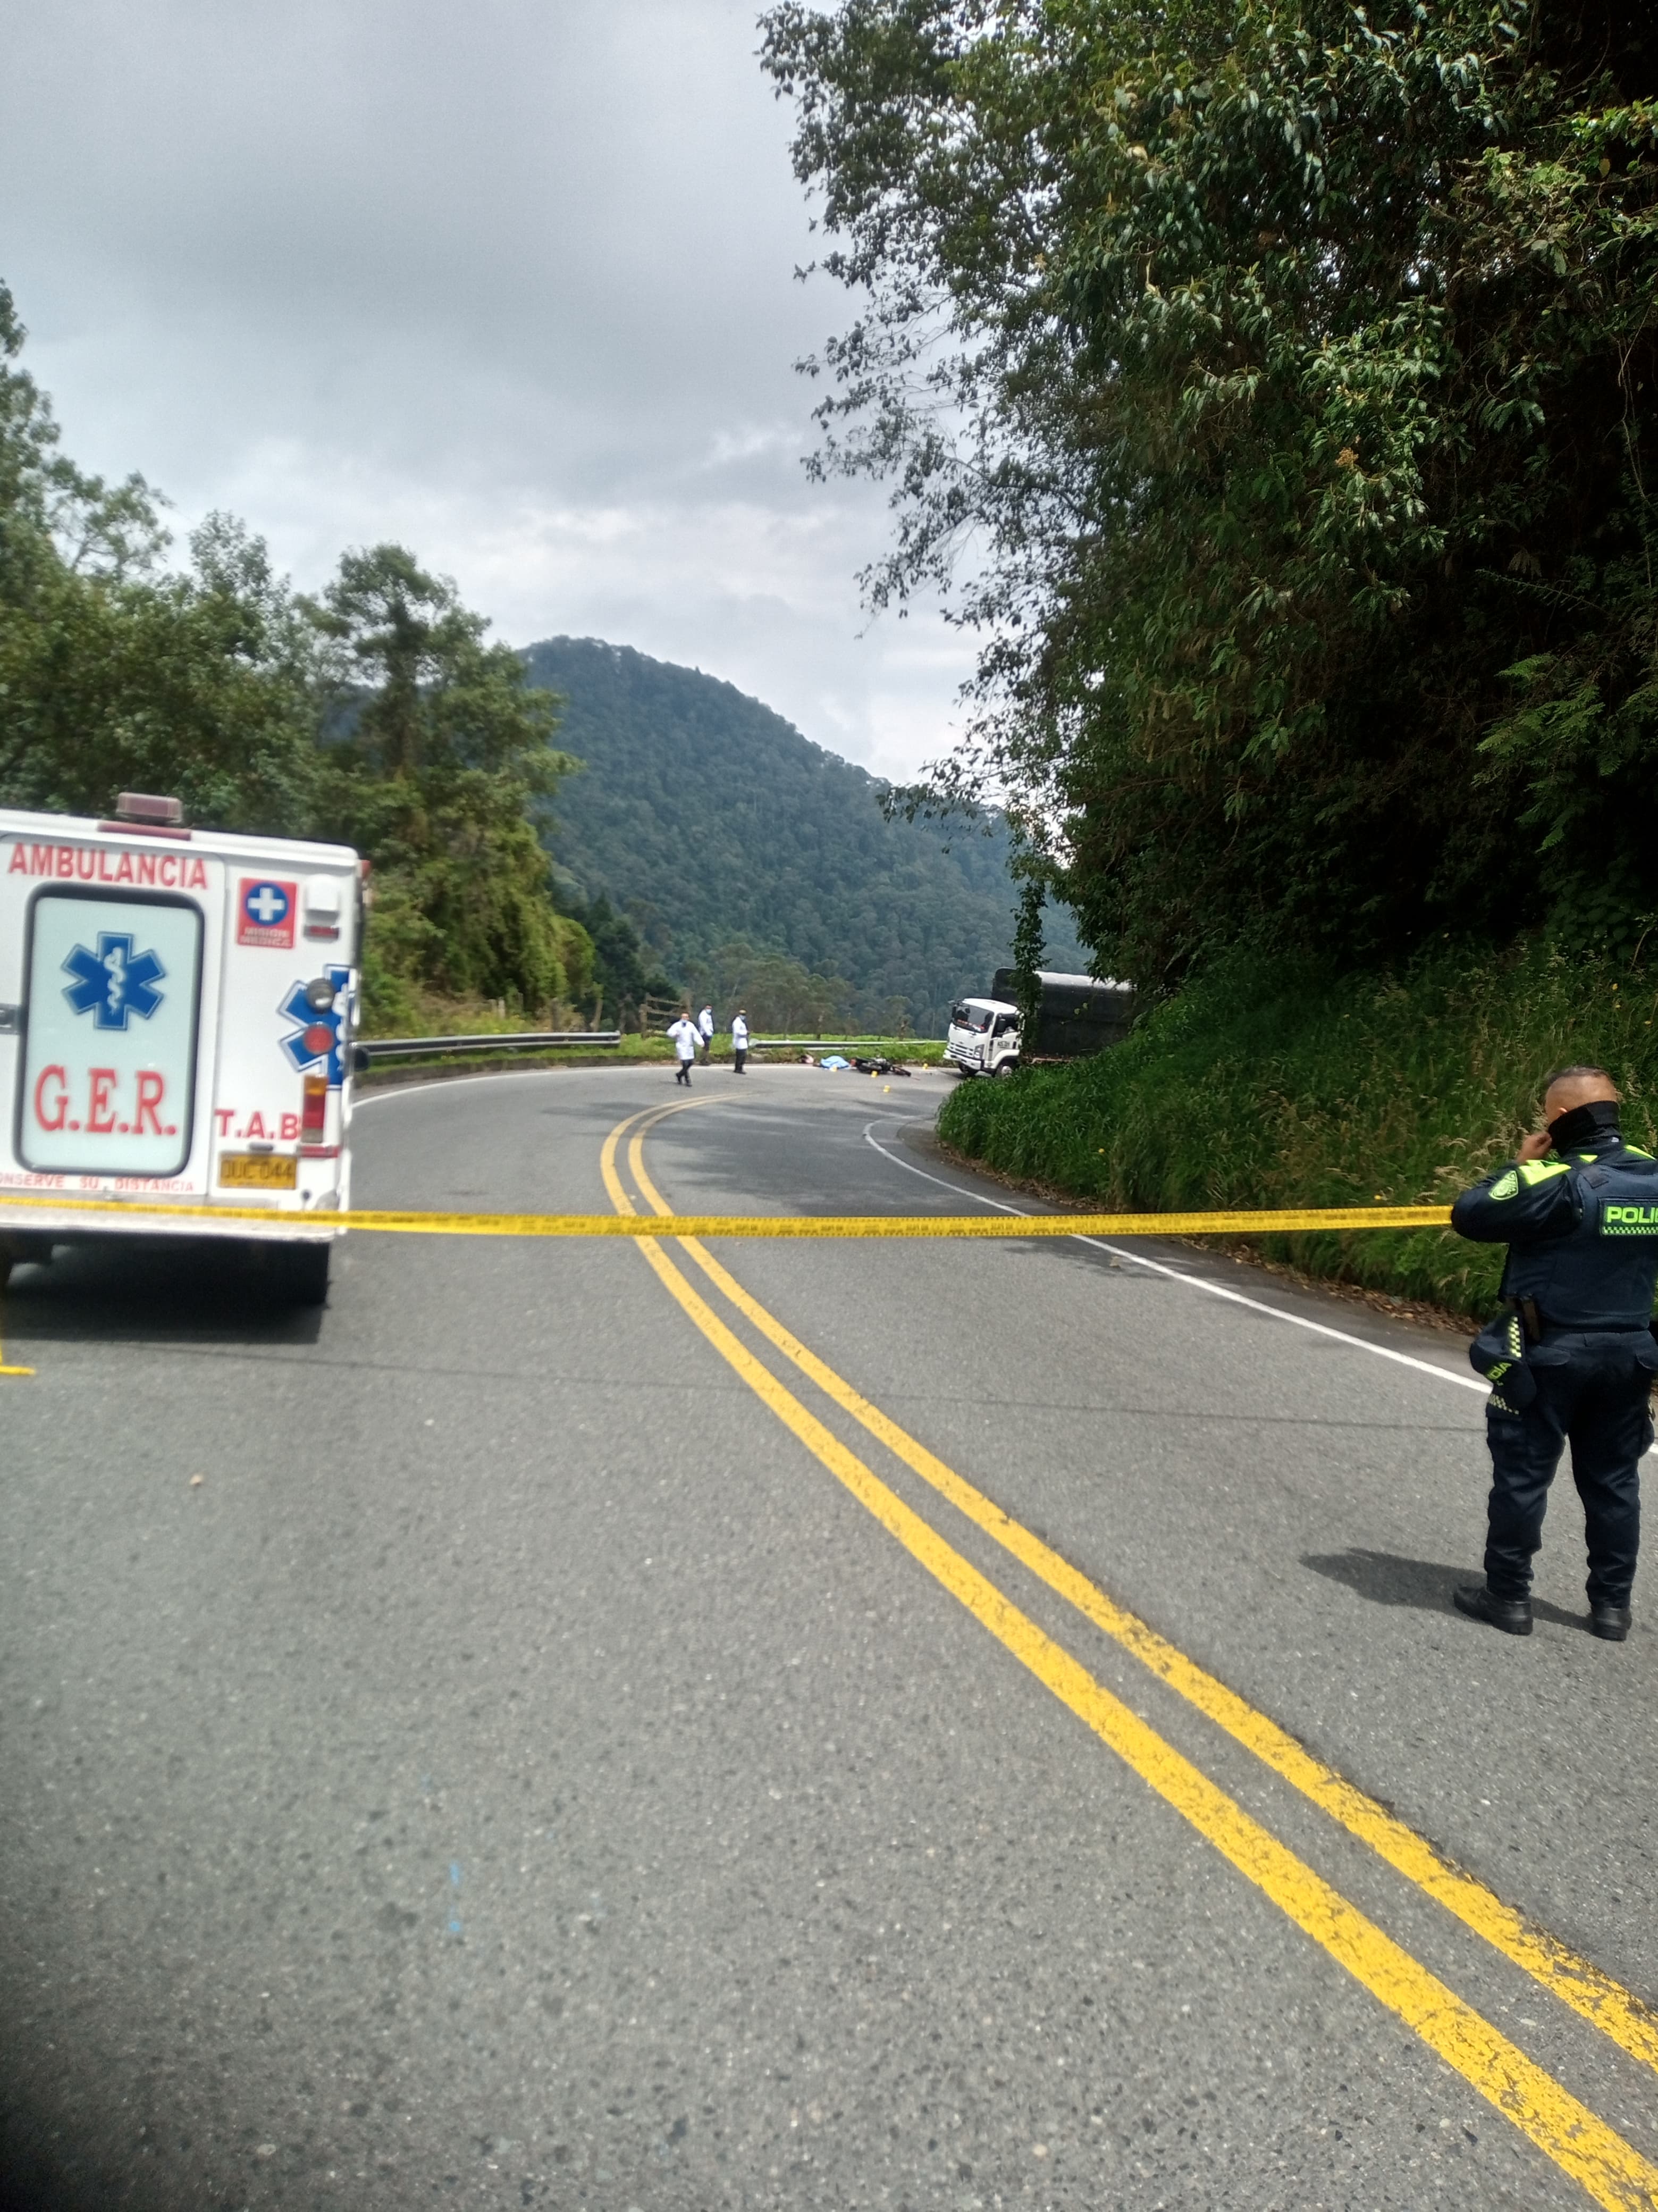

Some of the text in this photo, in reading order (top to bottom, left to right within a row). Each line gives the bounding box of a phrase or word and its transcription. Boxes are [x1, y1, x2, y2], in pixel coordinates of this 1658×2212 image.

[7, 842, 207, 890] AMBULANCIA
[34, 1064, 176, 1135] G.E.R.
[79, 1175, 100, 1190] SU
[114, 1176, 194, 1192] DISTANCIA
[1606, 1206, 1658, 1224] POLI
